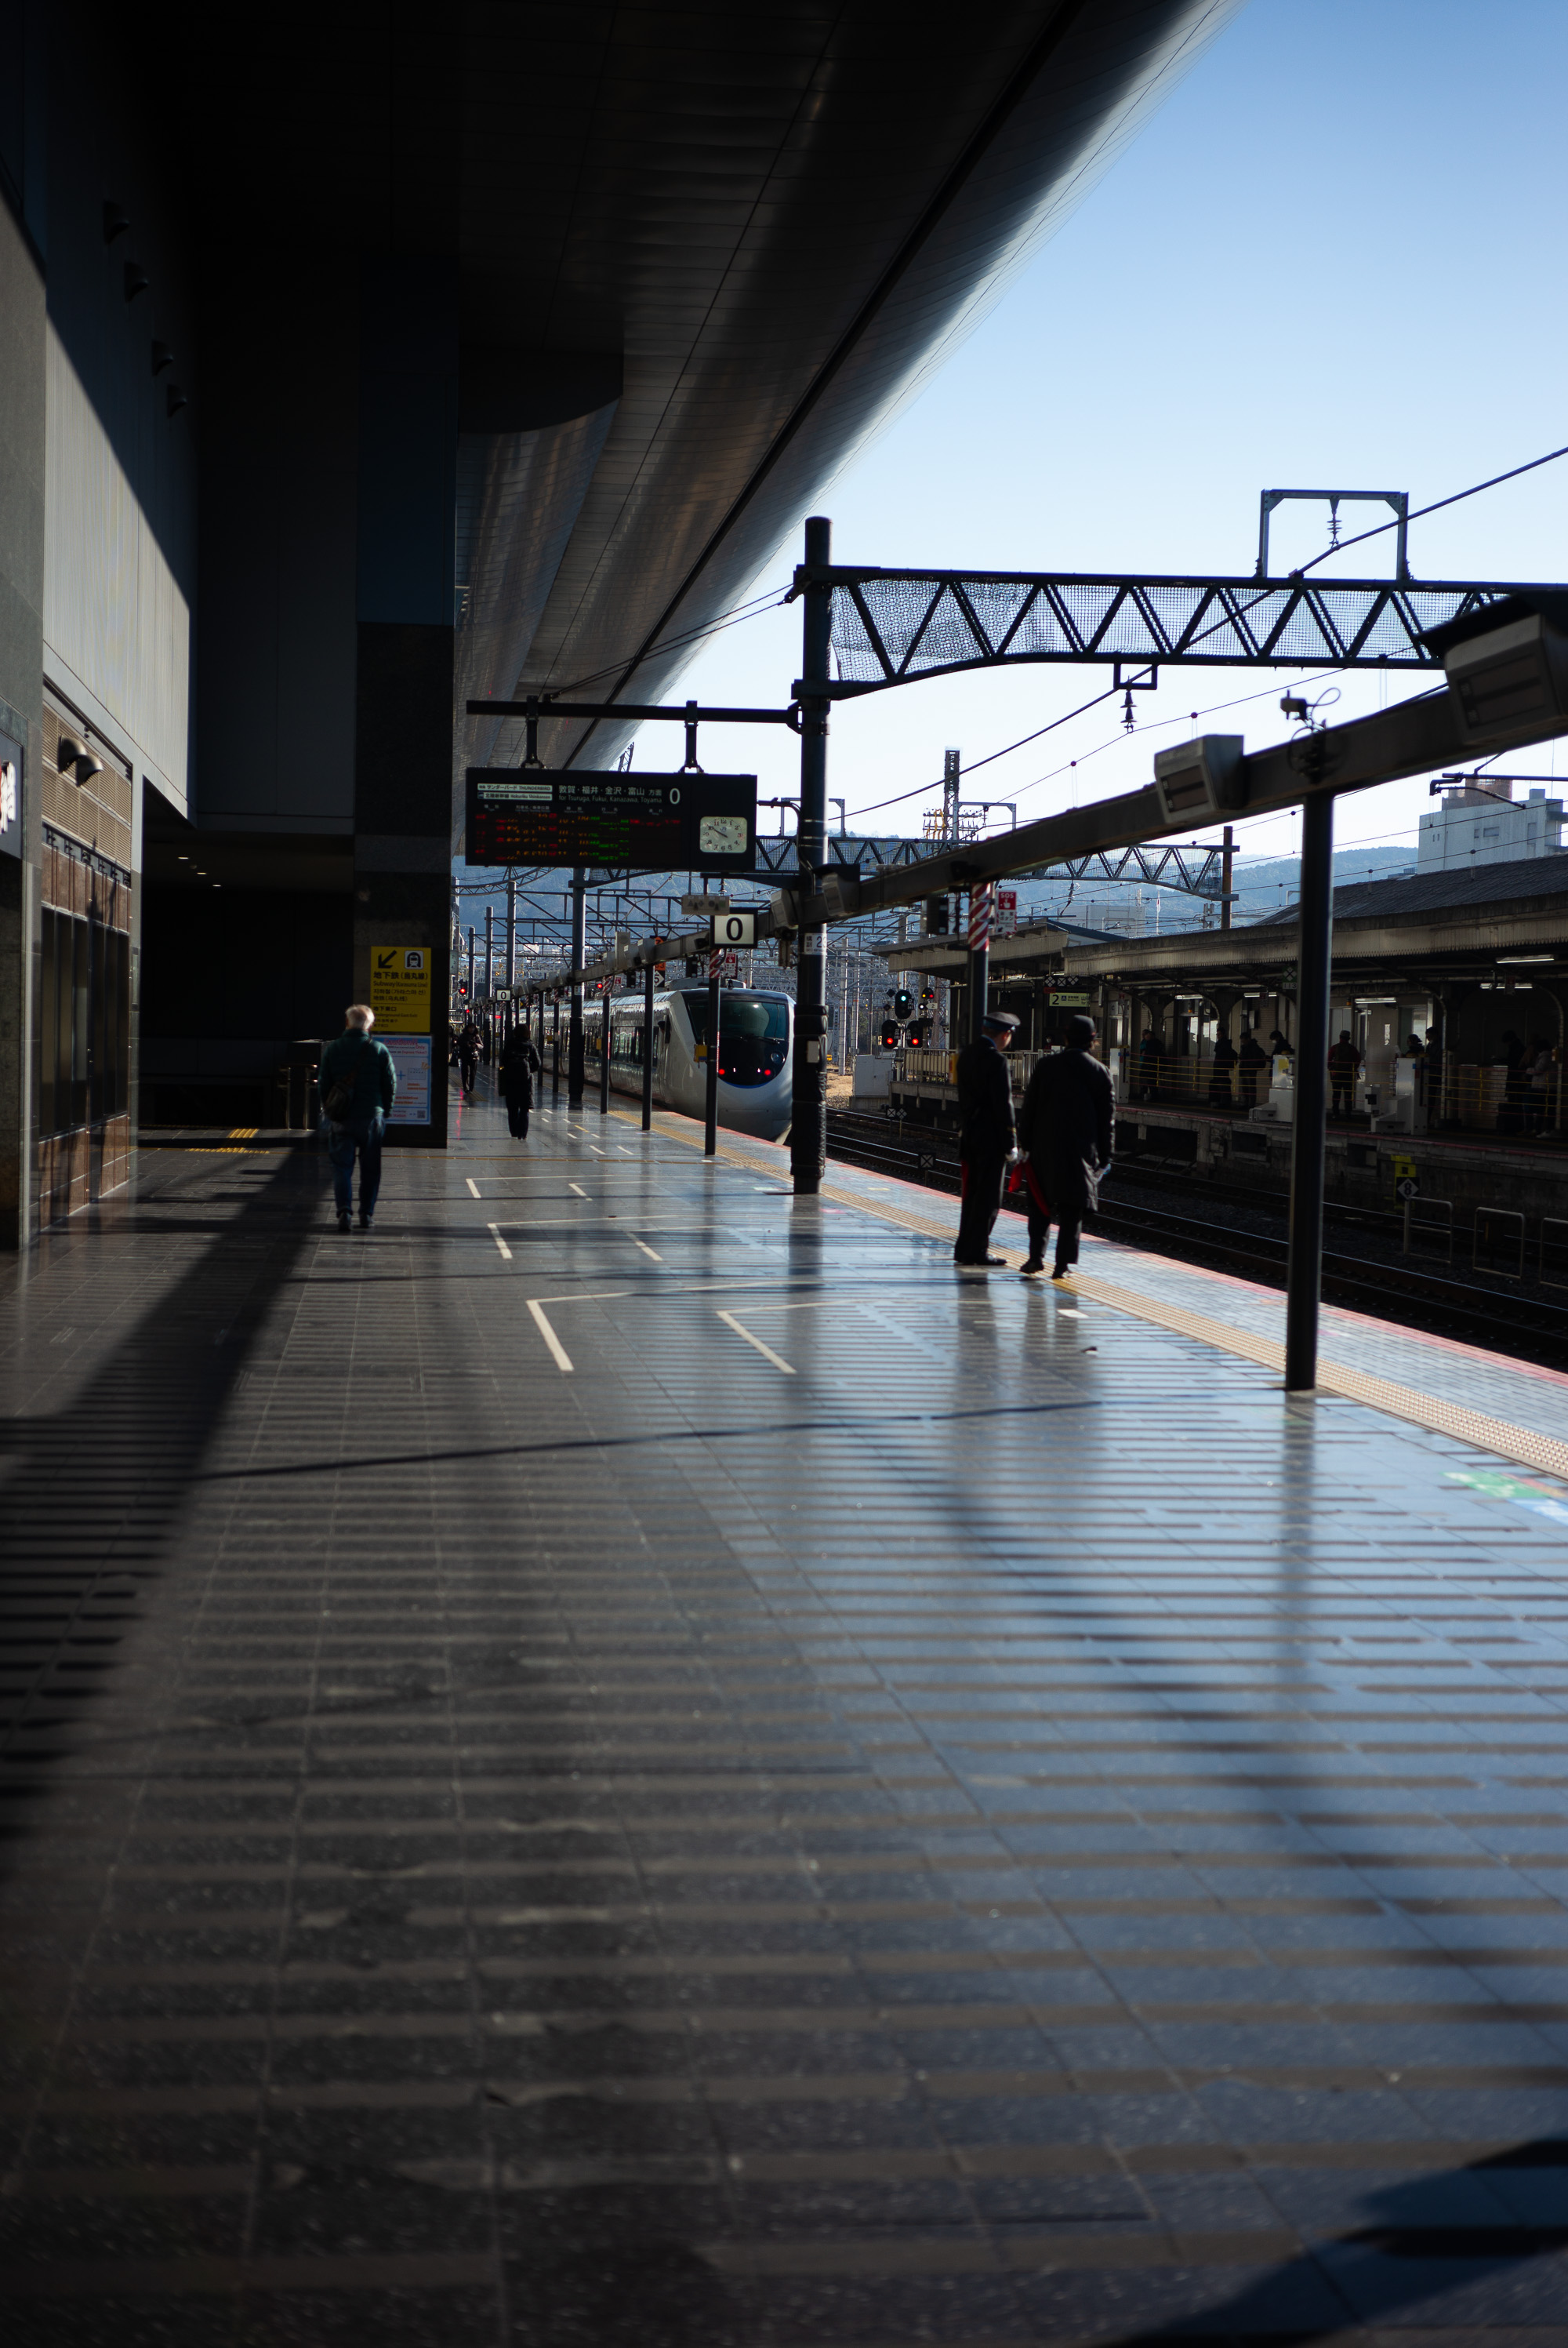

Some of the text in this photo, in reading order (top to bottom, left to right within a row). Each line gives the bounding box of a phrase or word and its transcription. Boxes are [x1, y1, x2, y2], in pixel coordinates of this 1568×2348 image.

[726, 917, 743, 941] 0
[500, 991, 507, 1000] 0
[1052, 994, 1060, 1005] 2
[1405, 1183, 1412, 1195] 8
